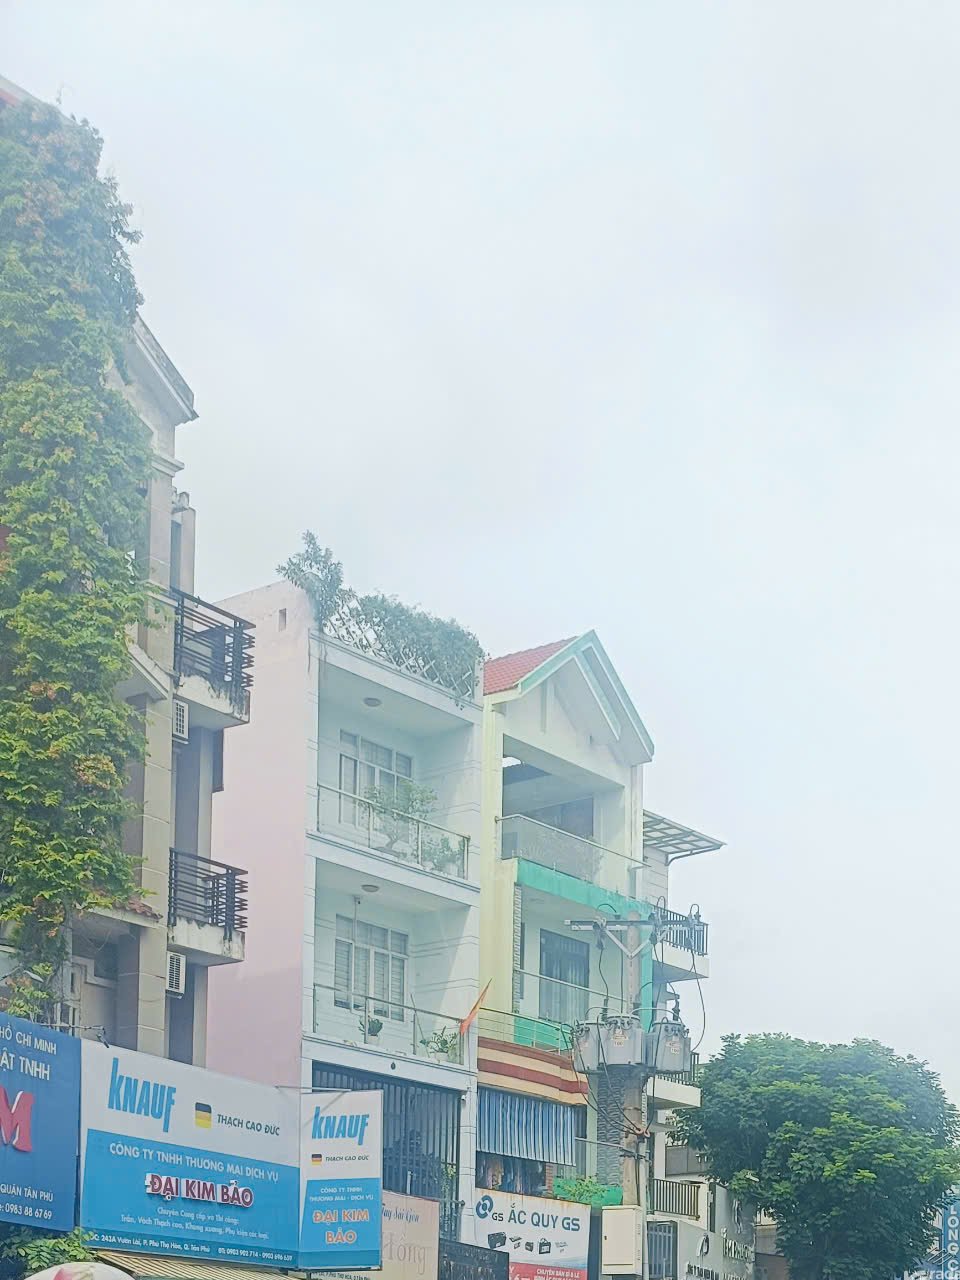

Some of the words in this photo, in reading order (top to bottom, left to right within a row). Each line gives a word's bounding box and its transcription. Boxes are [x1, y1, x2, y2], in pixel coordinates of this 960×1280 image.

[34, 1038, 57, 1055] MINH
[19, 1057, 51, 1081] TNHH
[107, 1057, 177, 1133] KNAUF
[245, 1121, 262, 1132] CAO
[311, 1106, 369, 1145] KNAUF
[109, 1141, 140, 1159] CÔNG
[143, 1149, 156, 1160] TY
[157, 1150, 183, 1166] TNHH
[147, 1173, 179, 1200] ĐẠI
[183, 1178, 216, 1201] KIM
[219, 1180, 254, 1208] BẢO
[313, 1209, 338, 1226] ĐẠI
[342, 1208, 369, 1222] KIM
[492, 1212, 504, 1222] GS
[562, 1216, 580, 1231] GS
[325, 1227, 357, 1244] BẢO
[947, 1205, 960, 1255] LONG
